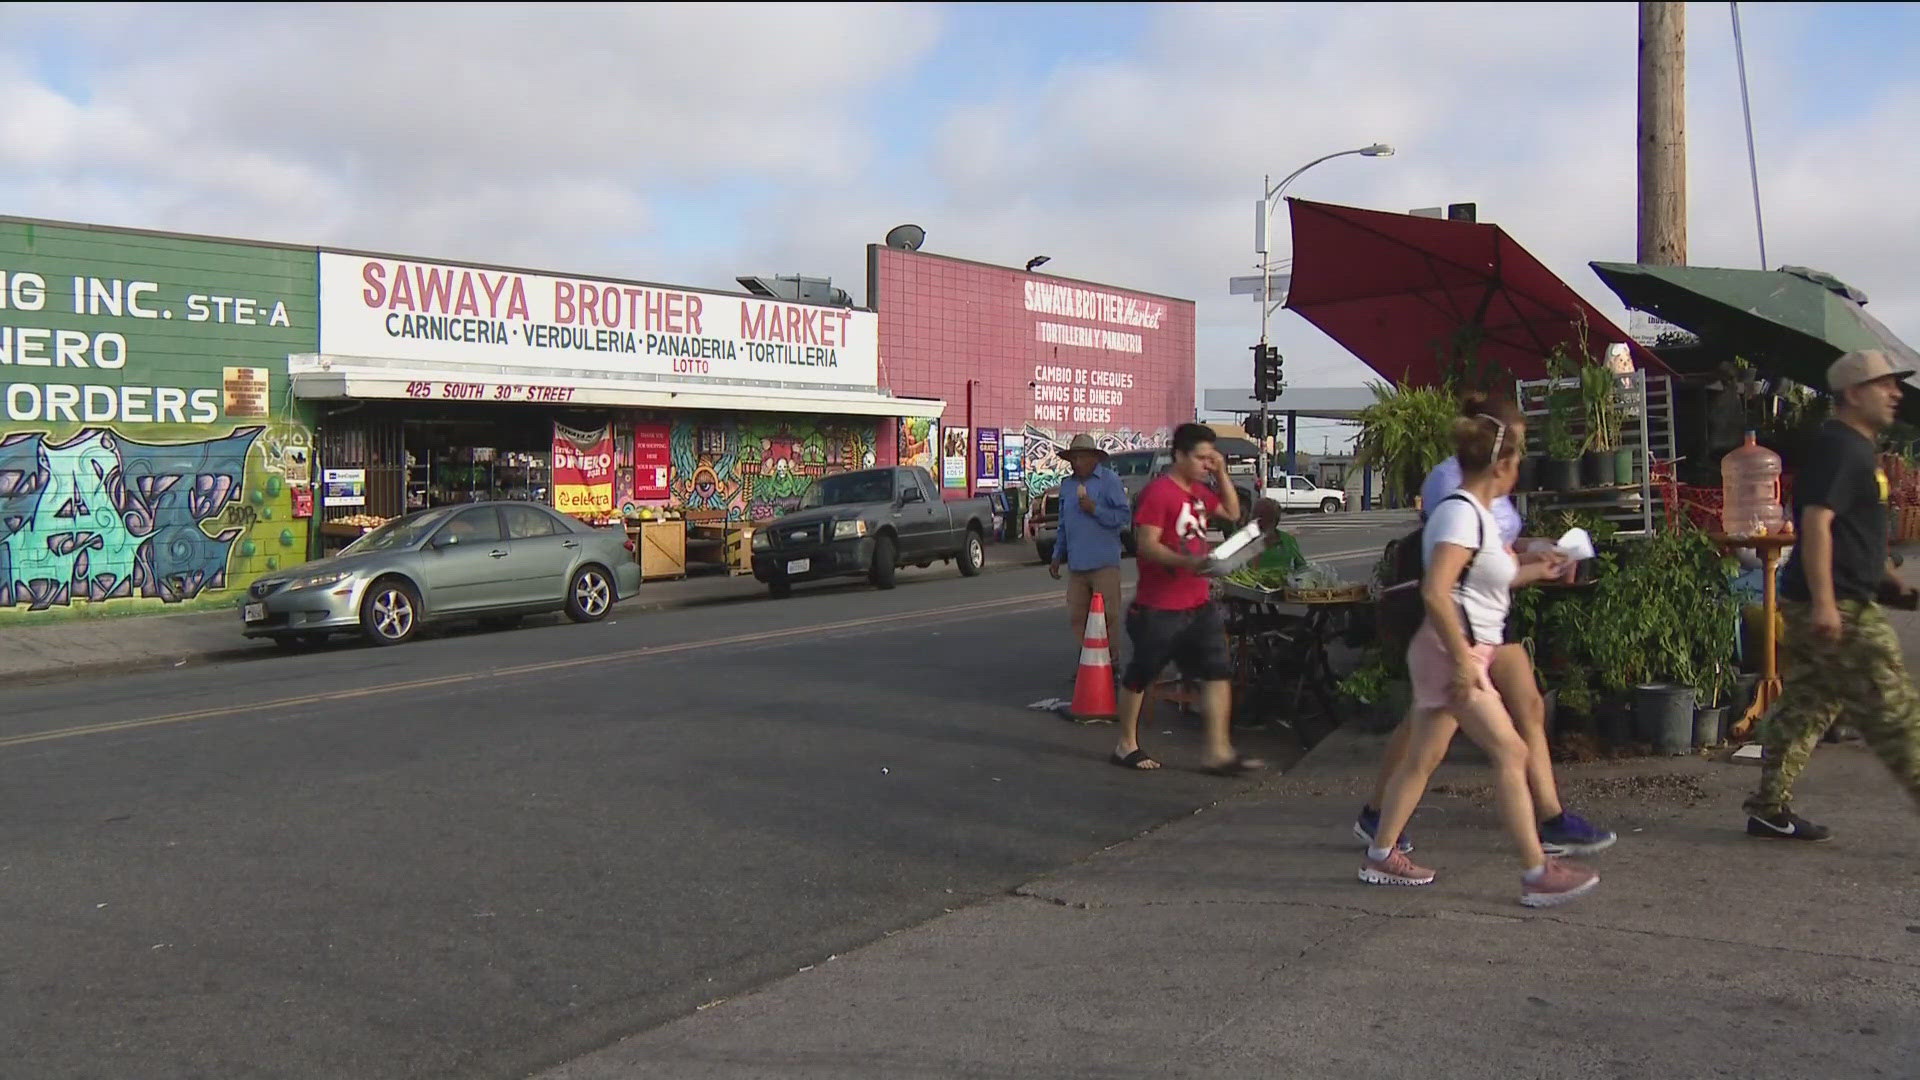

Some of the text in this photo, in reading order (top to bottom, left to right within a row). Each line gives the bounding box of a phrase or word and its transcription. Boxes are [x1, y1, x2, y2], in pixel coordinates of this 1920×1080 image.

[0, 271, 291, 328] G INC. STE-A
[362, 262, 851, 348] SAWAYA BROTHER MARKET
[1024, 280, 1162, 330] SAWAYA BROTHER Market
[385, 313, 838, 368] CARNICERIA VERDULERIA PANADERIA TORTILLERIA
[1041, 321, 1143, 354] TORTILLERIA Y PANADERIA
[673, 358, 709, 374] LOTTO
[1035, 365, 1134, 389] CAMBIO DE CHEQUES
[6, 382, 218, 424] ORDERS
[405, 381, 431, 398] 425
[442, 383, 485, 399] SOUTH
[526, 386, 575, 402] STREET
[1035, 386, 1123, 406] ENVIOS DE DINERO
[1034, 404, 1111, 423] MONEY ORDERS
[555, 453, 611, 471] DINERO
[571, 492, 609, 506] elektra
